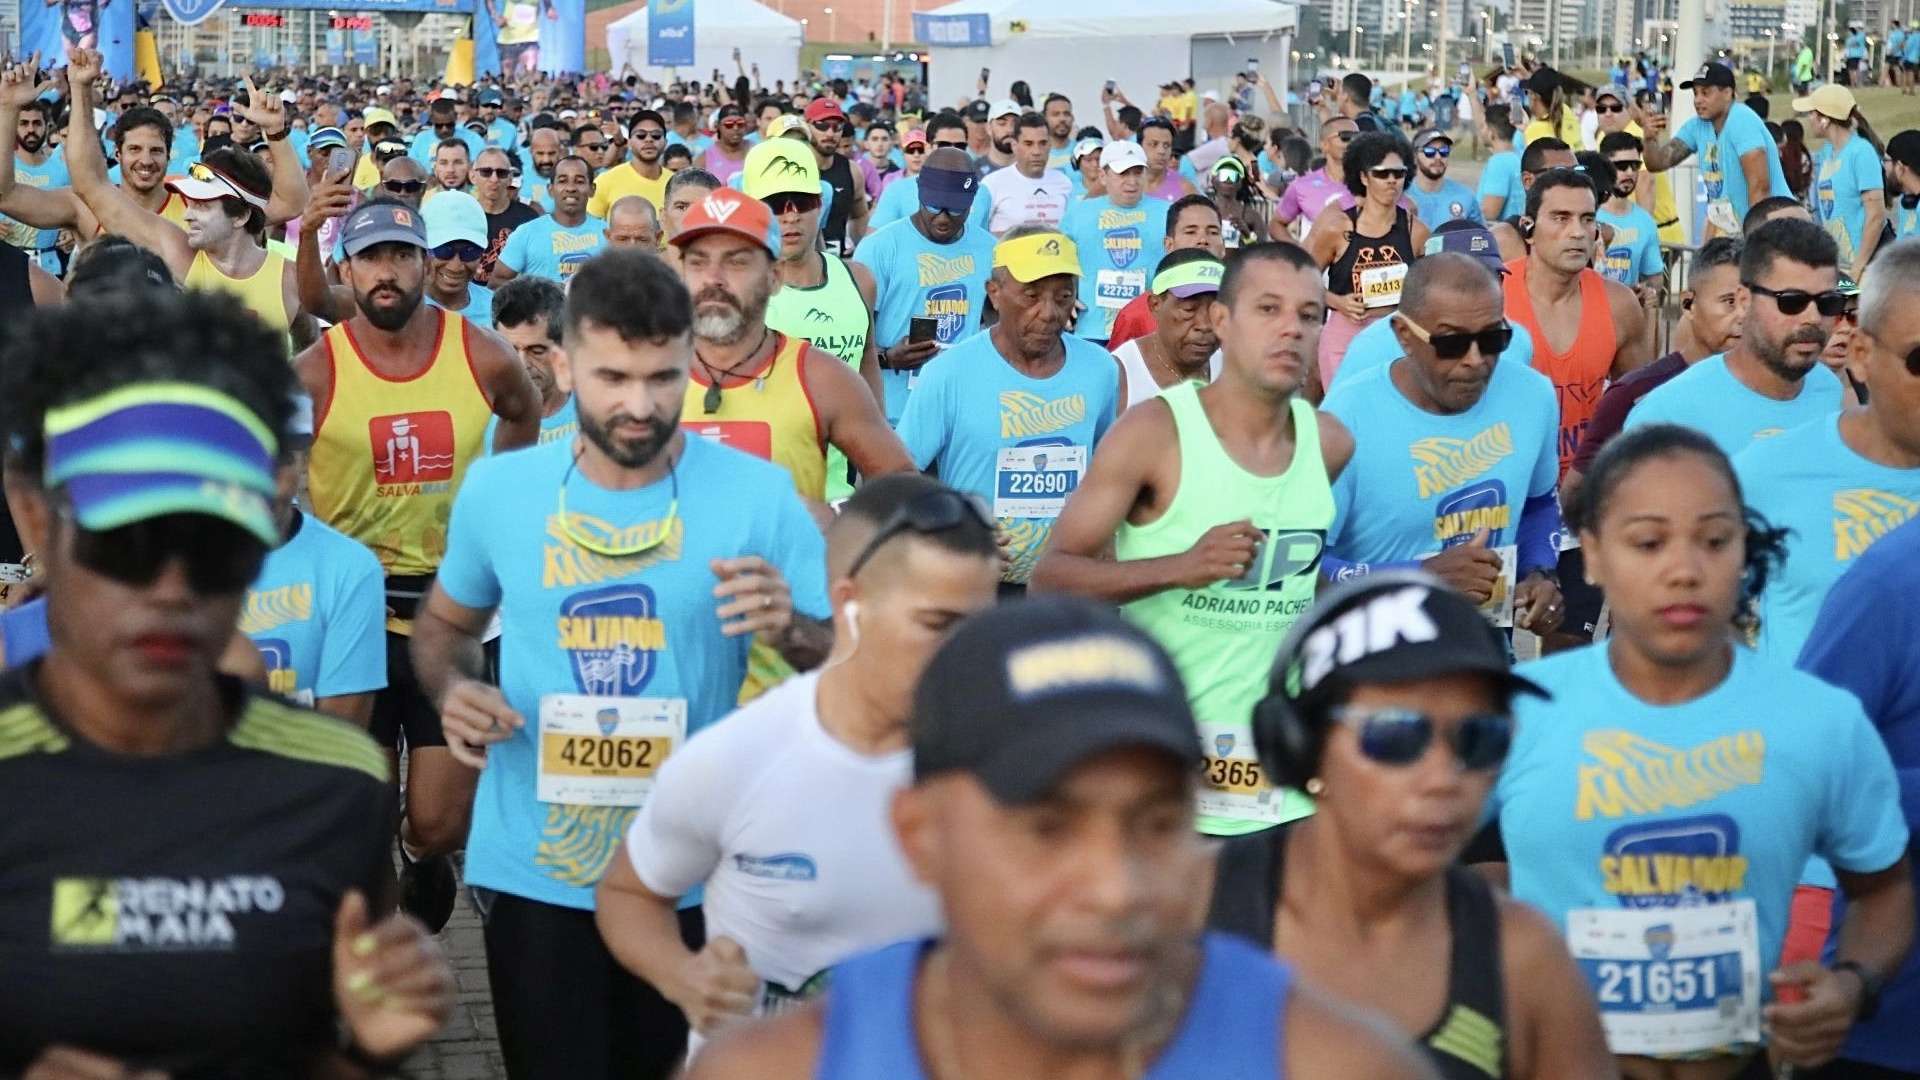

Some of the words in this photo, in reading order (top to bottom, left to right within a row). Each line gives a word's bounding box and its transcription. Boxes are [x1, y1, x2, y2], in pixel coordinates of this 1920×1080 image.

[1103, 284, 1135, 297] 22732
[1370, 279, 1401, 294] 42413
[799, 334, 864, 350] ALVA
[1009, 473, 1067, 493] 22690
[1434, 505, 1511, 541] SALVADOR
[1182, 592, 1260, 615] ADRIANO
[557, 615, 667, 651] SALVADOR
[1183, 614, 1262, 632] ASSESSORIA
[1302, 585, 1440, 690] 21K
[561, 738, 653, 768] 42062
[1600, 853, 1748, 894] SALVADOR
[116, 876, 286, 915] RENATO
[114, 911, 236, 945] MAIA
[1598, 959, 1717, 1004] 21651
